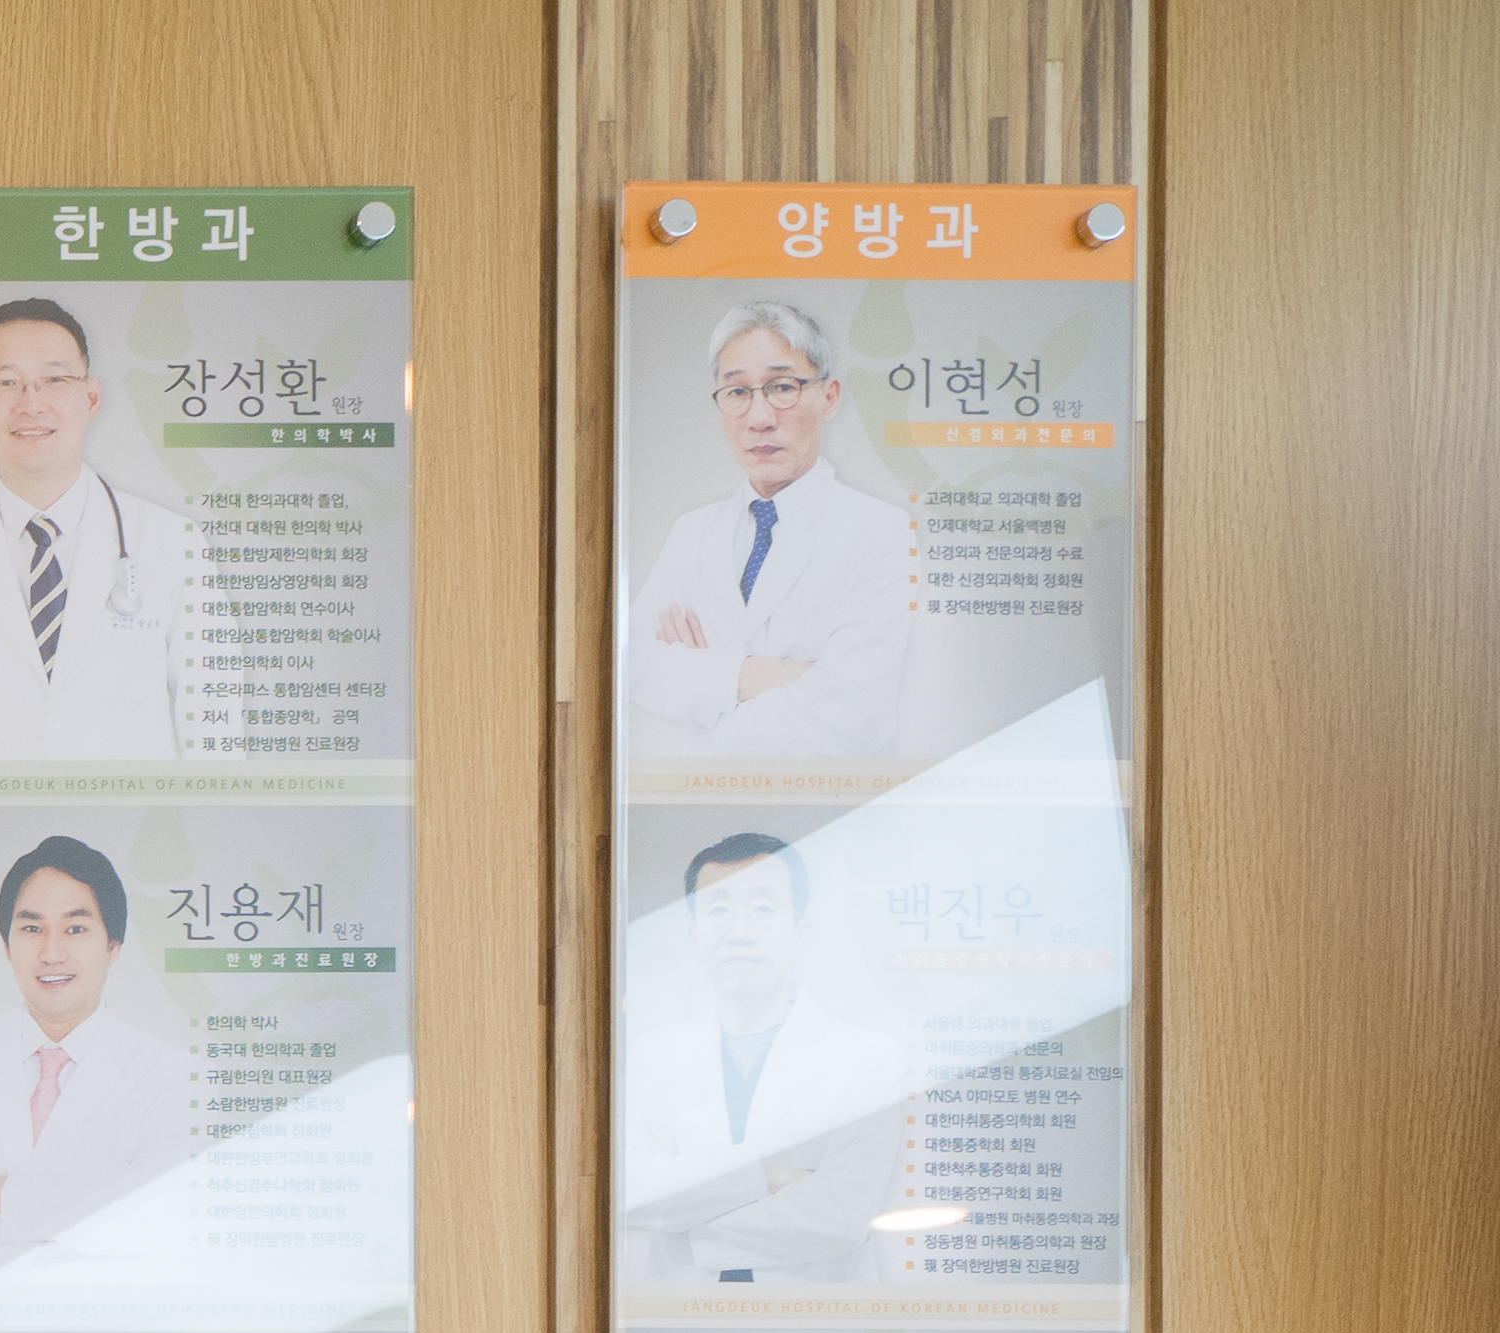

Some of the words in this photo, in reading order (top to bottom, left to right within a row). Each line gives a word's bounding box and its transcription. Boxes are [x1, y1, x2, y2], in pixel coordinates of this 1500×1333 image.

[52, 205, 255, 263] 한방과
[777, 202, 980, 260] 양방과
[163, 358, 327, 418] 장성환
[331, 396, 364, 416] 원장
[887, 357, 1041, 417] 이현성
[1052, 399, 1084, 419] 원장
[271, 428, 377, 443] 한의학박사
[946, 428, 1096, 443] 신경외과전문의
[201, 520, 242, 536] 가천대
[245, 519, 287, 536] 대학원
[290, 519, 332, 536] 한의학
[335, 520, 364, 536] 박사
[927, 571, 955, 588] 대한
[958, 572, 1039, 589] 신경외과학회
[1043, 572, 1083, 589] 정회원
[166, 882, 323, 942] 진용재
[332, 922, 365, 942] 원장
[226, 953, 378, 968] 한방과진료원장
